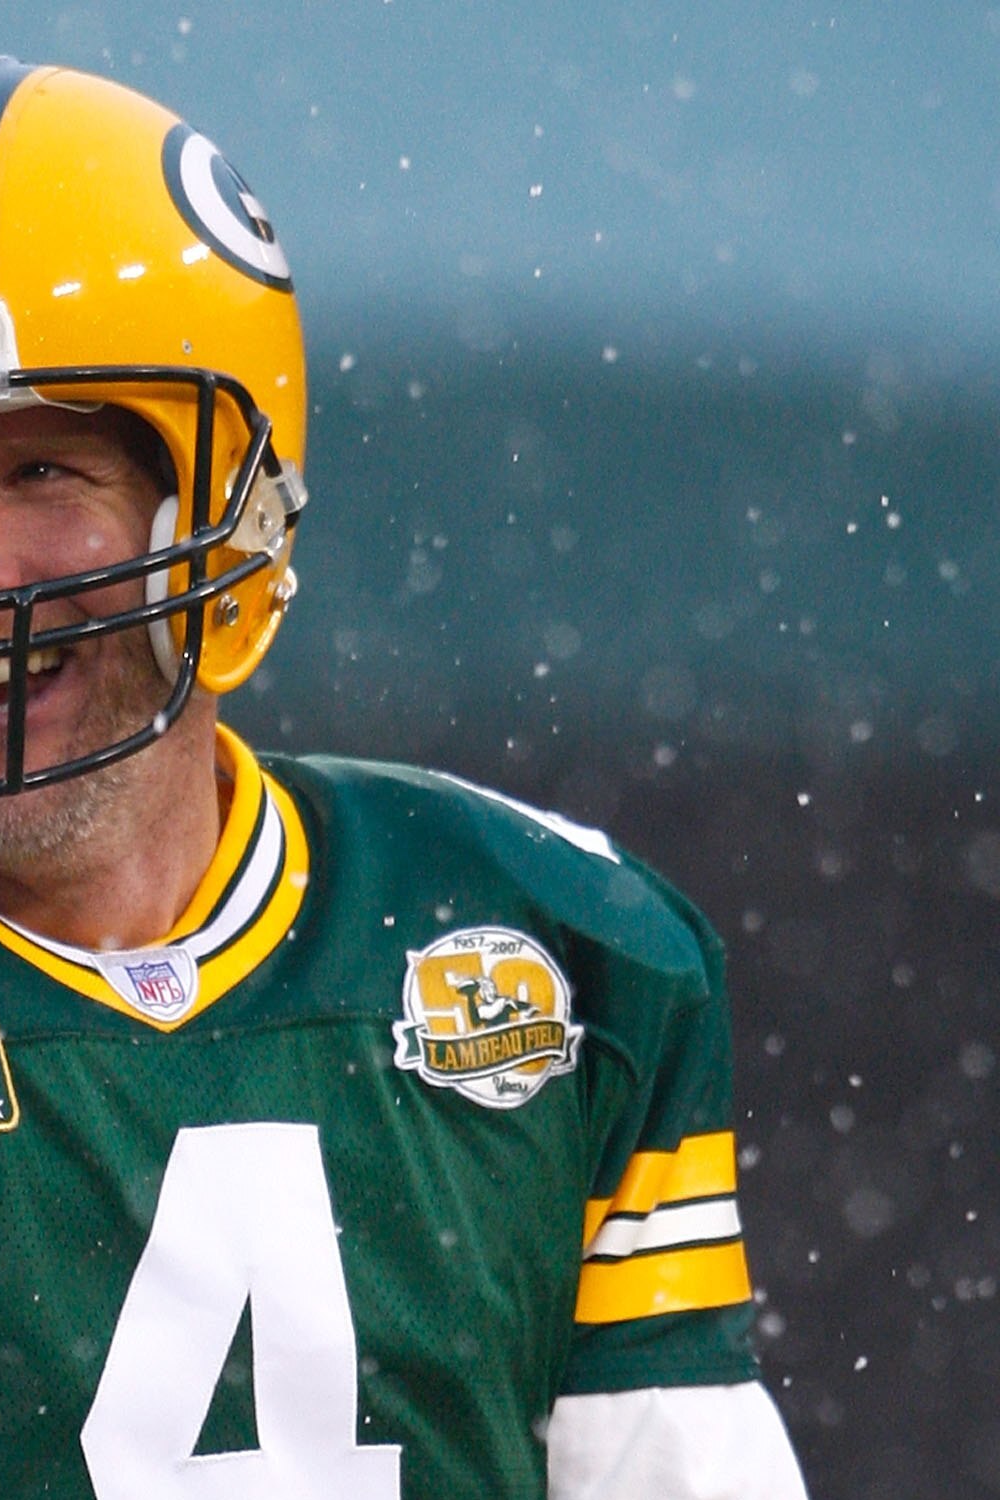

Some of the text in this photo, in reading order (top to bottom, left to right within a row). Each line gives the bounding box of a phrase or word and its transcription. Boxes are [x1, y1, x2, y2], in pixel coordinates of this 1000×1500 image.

[139, 979, 181, 1003] NFL
[428, 1024, 562, 1070] LAMBEAU FIELD
